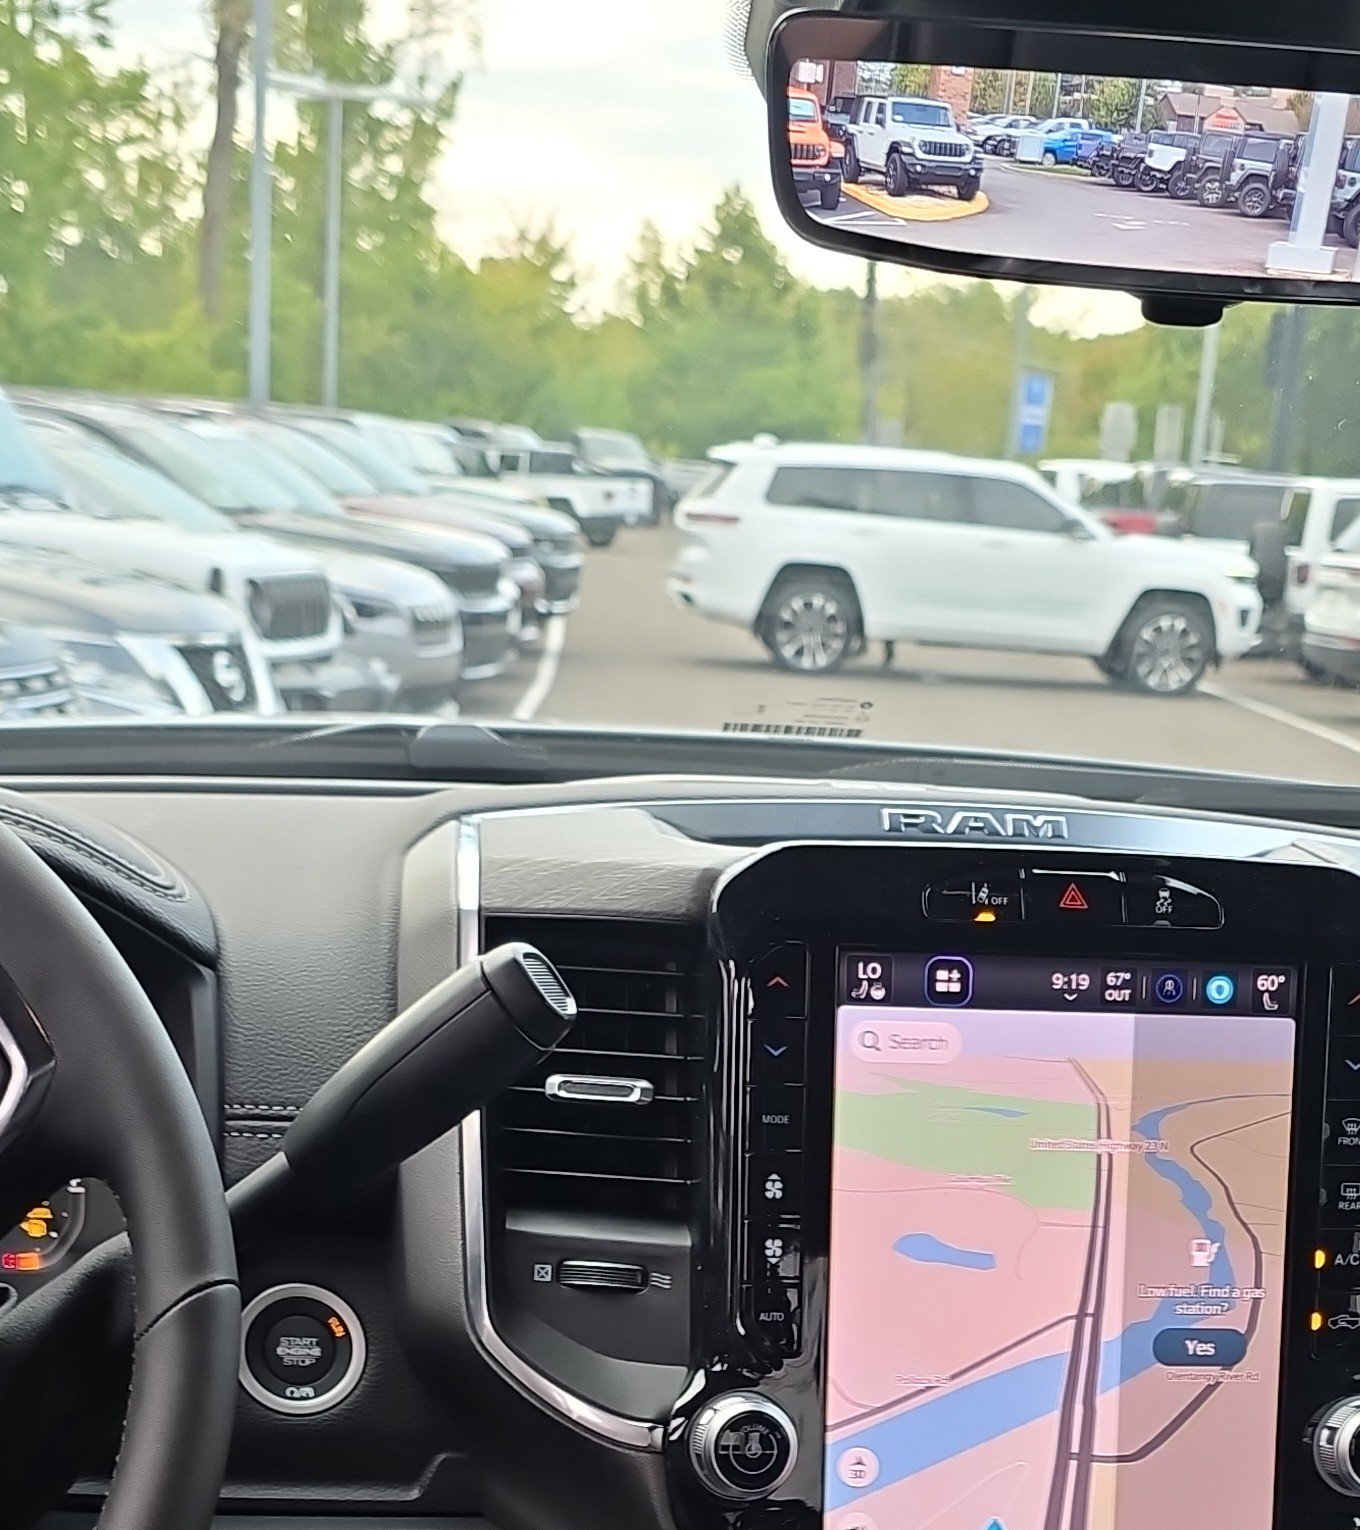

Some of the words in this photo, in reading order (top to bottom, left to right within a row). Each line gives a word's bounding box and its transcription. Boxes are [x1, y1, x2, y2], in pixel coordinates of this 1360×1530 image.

[879, 808, 1069, 841] RAM
[990, 897, 1010, 907] OFF
[1155, 904, 1174, 914] OFF
[857, 961, 883, 980] LO
[1051, 972, 1090, 991] 9:19
[1106, 971, 1132, 986] 67°
[1256, 974, 1287, 992] 60°
[1104, 988, 1132, 1002] OUT
[888, 1033, 949, 1051] Search
[761, 1114, 790, 1125] MODE
[1145, 1140, 1158, 1151] 23
[1161, 1140, 1169, 1151] N
[1334, 1253, 1360, 1266] A/C
[1138, 1284, 1163, 1298] Low
[1200, 1284, 1230, 1298] Find
[1231, 1287, 1240, 1298] a
[1241, 1287, 1266, 1301] gas
[1174, 1301, 1229, 1316] station?
[758, 1311, 785, 1322] AUTO
[279, 1336, 320, 1346] START
[1184, 1339, 1217, 1356] Yes
[275, 1346, 322, 1357] ENGINE
[282, 1357, 317, 1367] STOP
[1165, 1371, 1218, 1385] Olentangy
[1219, 1371, 1245, 1381] River
[1246, 1371, 1259, 1381] Rd
